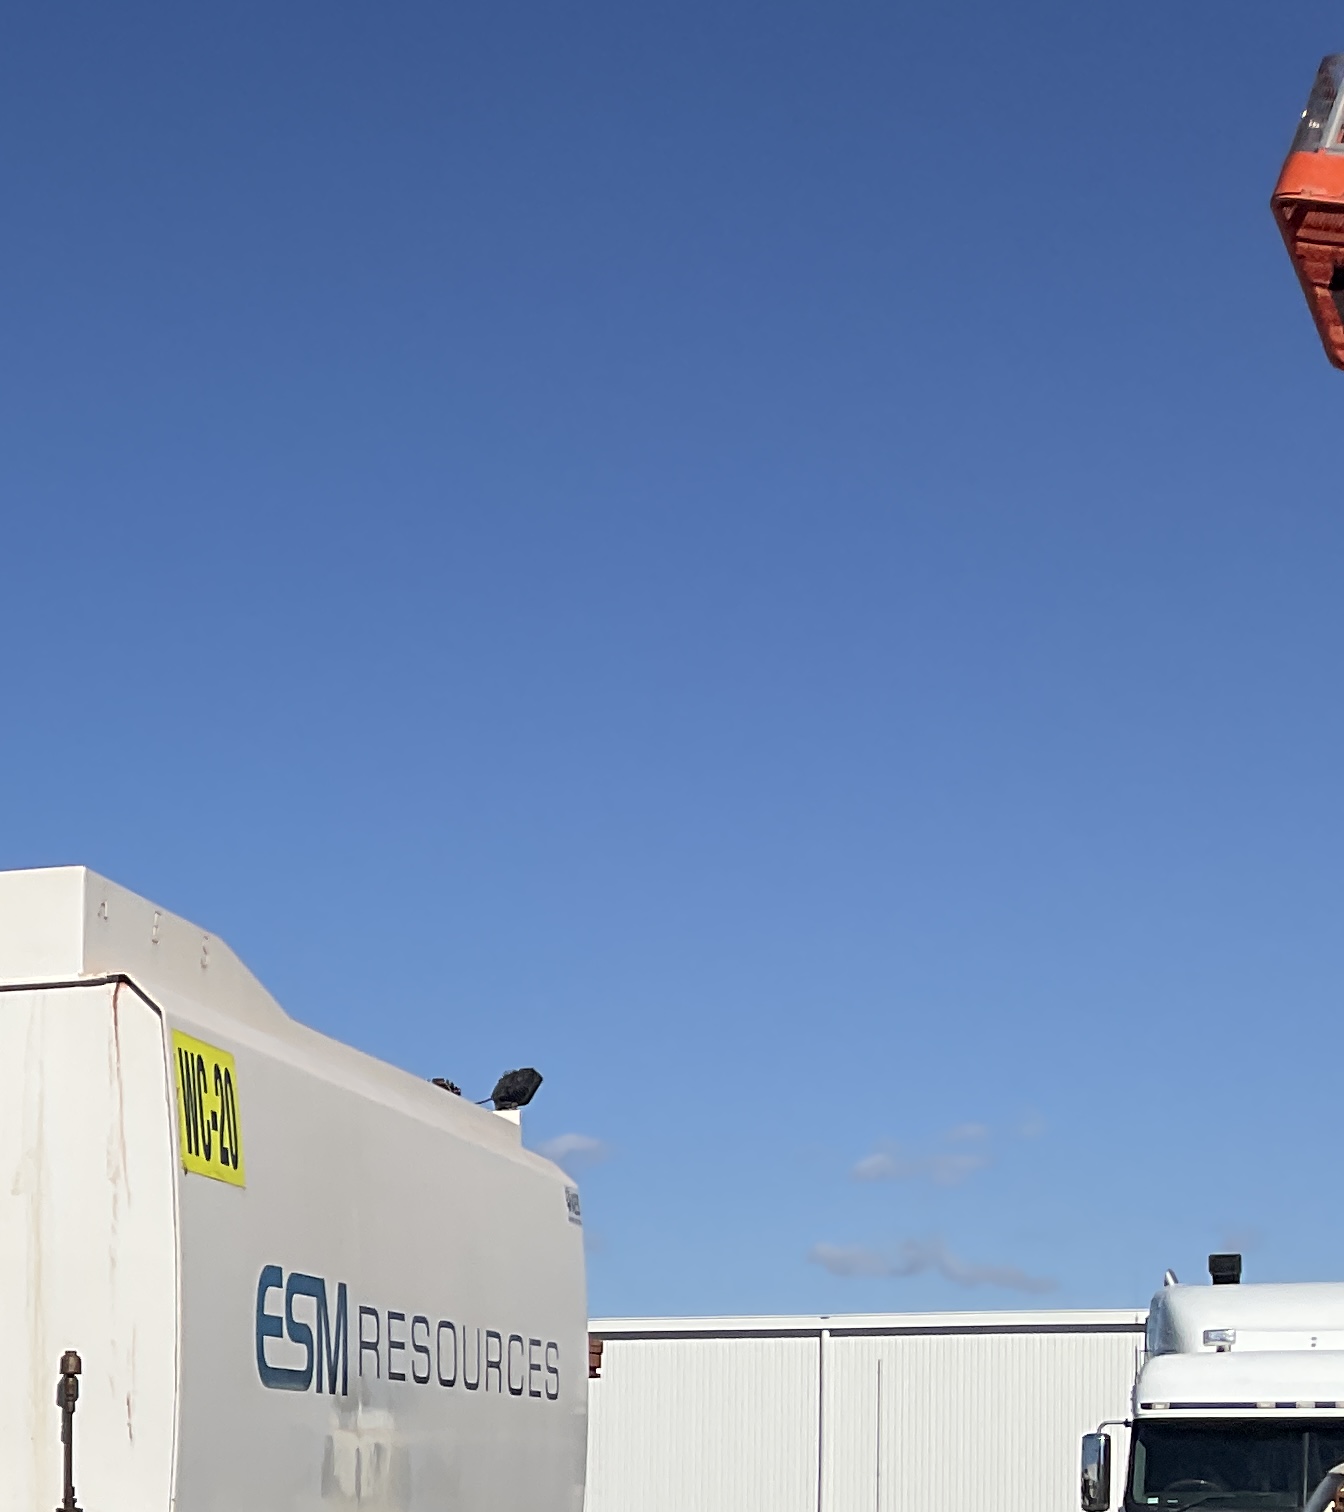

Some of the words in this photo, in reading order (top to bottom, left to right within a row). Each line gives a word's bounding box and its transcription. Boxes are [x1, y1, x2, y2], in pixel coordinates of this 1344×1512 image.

[178, 1047, 238, 1170] WC-20
[255, 1264, 348, 1397] ESM
[359, 1305, 559, 1400] RESOURCES
